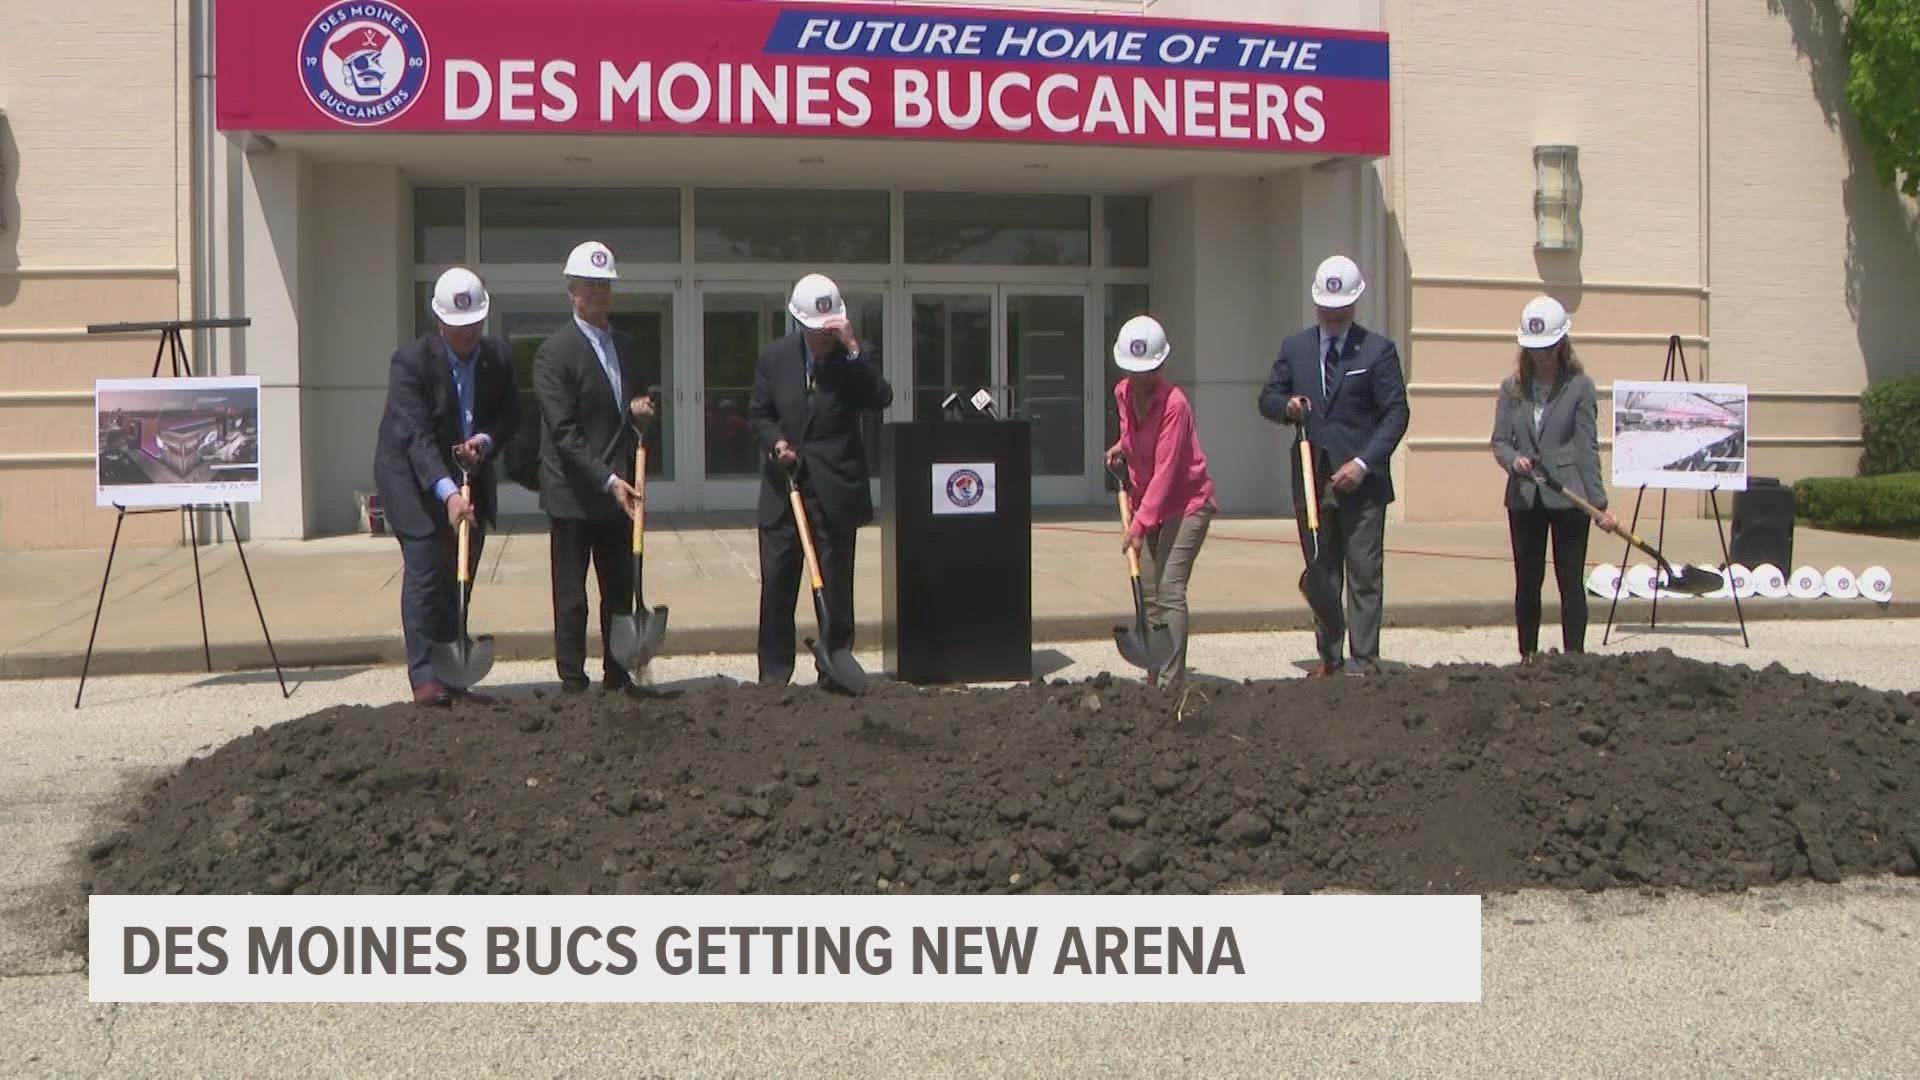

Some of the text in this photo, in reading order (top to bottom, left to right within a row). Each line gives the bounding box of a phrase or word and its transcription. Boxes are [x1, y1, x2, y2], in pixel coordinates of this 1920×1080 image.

[319, 5, 409, 35] DES MOINES
[797, 18, 1323, 71] FUTURE HOME OF THE
[305, 56, 318, 67] 19
[408, 57, 424, 67] 80
[318, 89, 410, 118] BUCCANEERS
[444, 58, 1326, 143] DES MOINES BUCCANEERS
